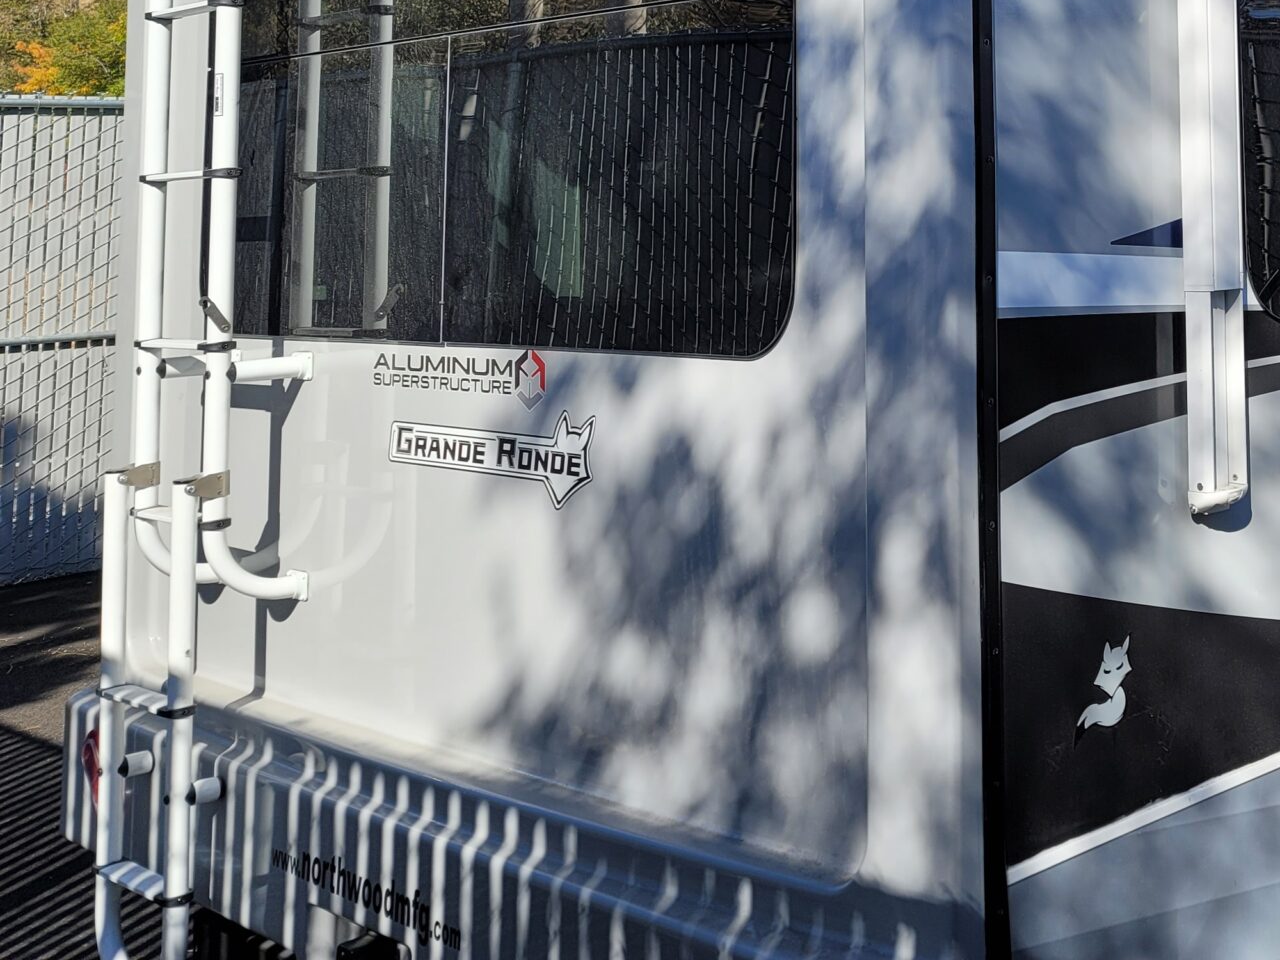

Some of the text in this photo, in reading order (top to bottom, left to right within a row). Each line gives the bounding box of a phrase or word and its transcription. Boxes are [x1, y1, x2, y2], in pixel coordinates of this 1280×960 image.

[373, 352, 513, 378] ALUMINUM
[373, 372, 512, 395] SUPERSTRUCTURE
[396, 426, 582, 477] GRANDE RONDE
[271, 848, 462, 951] www.northwoodmfg.com
